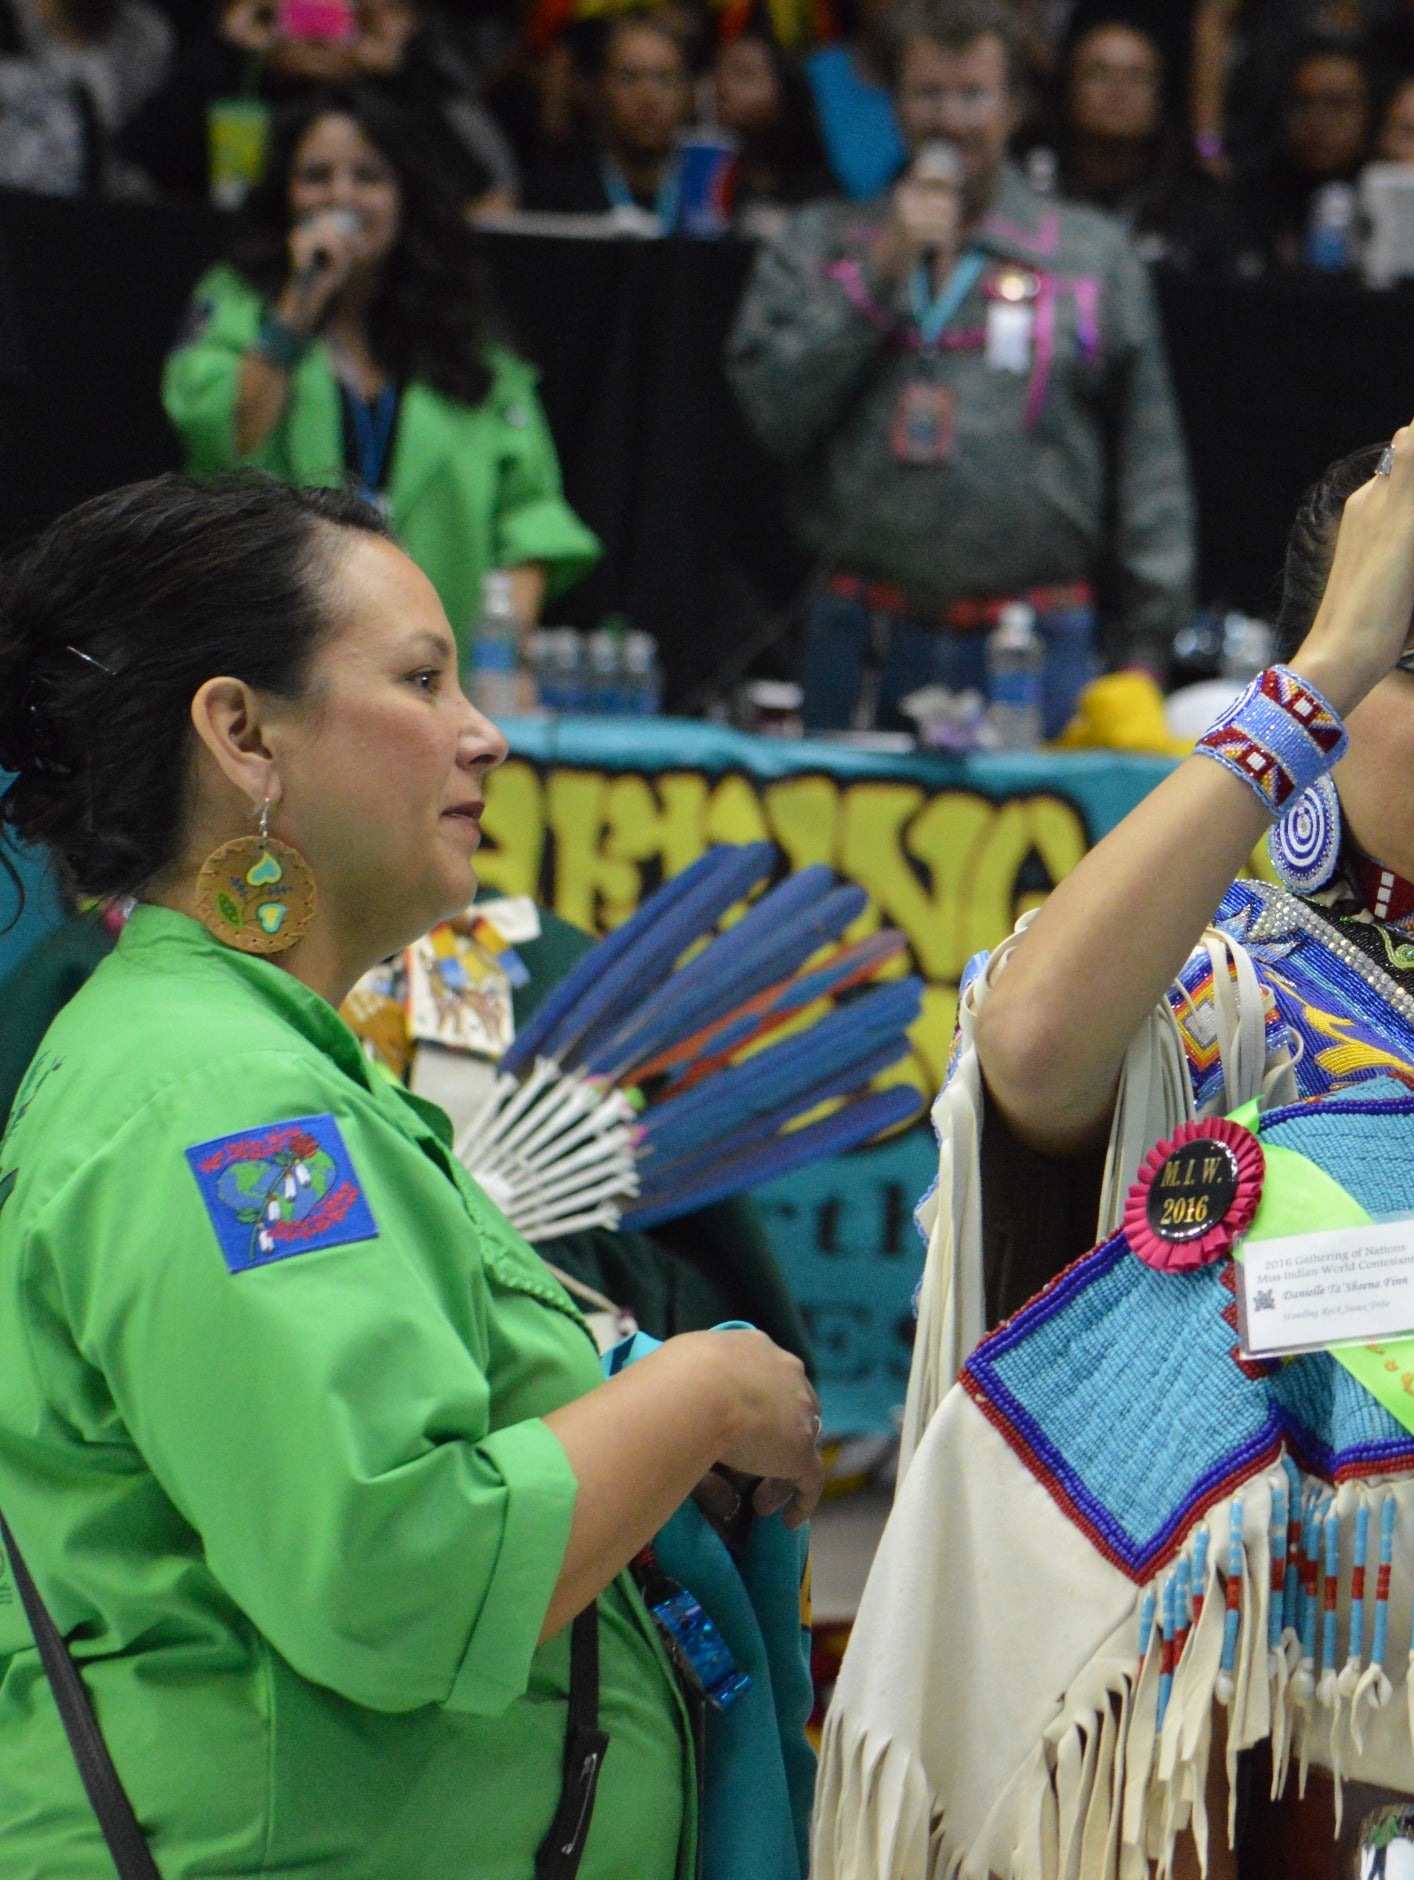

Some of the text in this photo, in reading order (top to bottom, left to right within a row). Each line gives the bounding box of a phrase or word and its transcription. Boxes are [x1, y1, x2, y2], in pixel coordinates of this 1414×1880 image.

[1159, 1195, 1210, 1226] 2016
[1256, 1254, 1414, 1285] Miss Indian World Contestant
[1264, 1243, 1406, 1270] 2016 Gathering of Nations
